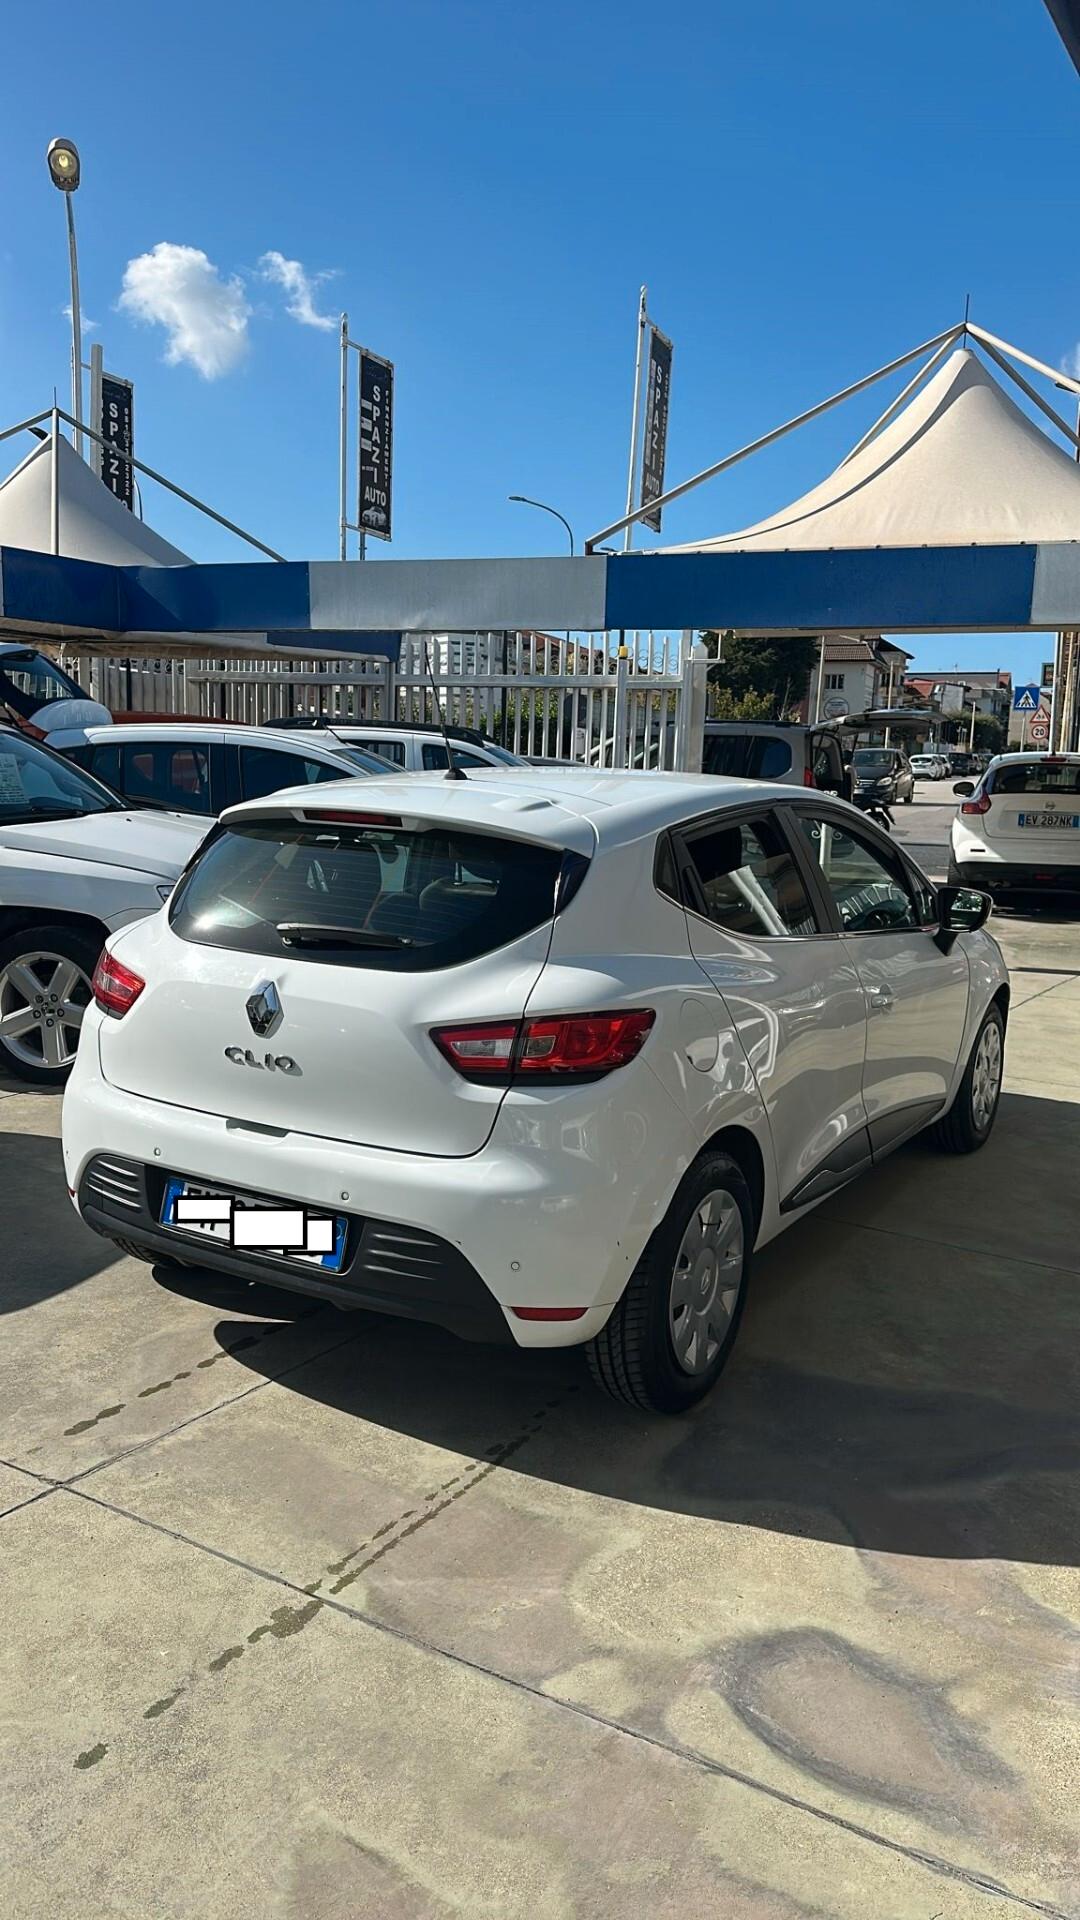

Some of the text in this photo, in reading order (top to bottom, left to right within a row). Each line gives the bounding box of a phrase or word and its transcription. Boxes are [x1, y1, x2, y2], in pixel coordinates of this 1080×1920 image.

[651, 365, 663, 471] SPAZI
[371, 385, 381, 484] SPAZI
[364, 485, 387, 507] AUTO
[645, 471, 660, 496] AUTO
[1034, 728, 1045, 736] 20
[1025, 815, 1072, 826] EV 287NK
[224, 1046, 297, 1073] CLIO
